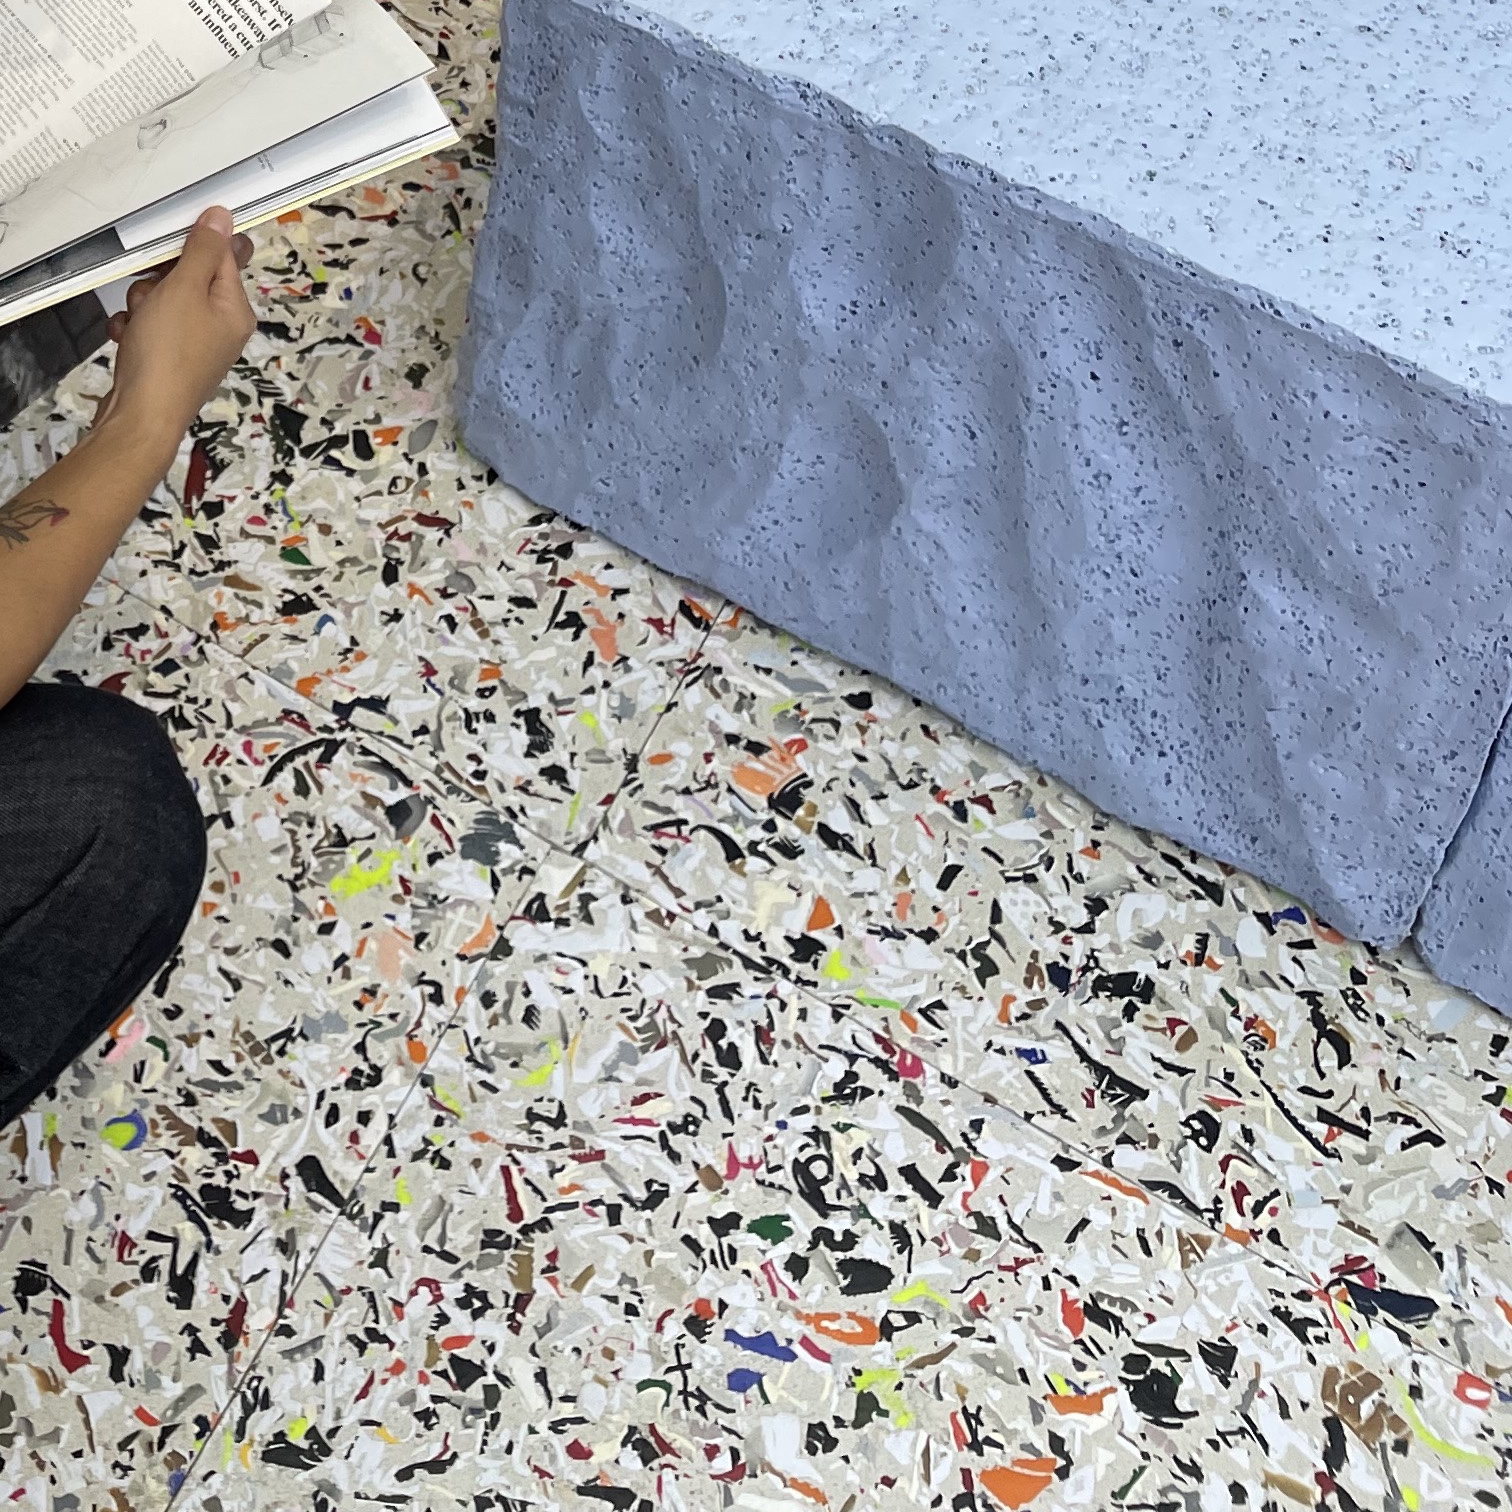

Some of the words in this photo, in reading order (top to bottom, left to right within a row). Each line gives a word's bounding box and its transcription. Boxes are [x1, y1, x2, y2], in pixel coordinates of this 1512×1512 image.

[188, 0, 204, 17] an
[228, 22, 237, 32] a
[268, 18, 282, 36] If
